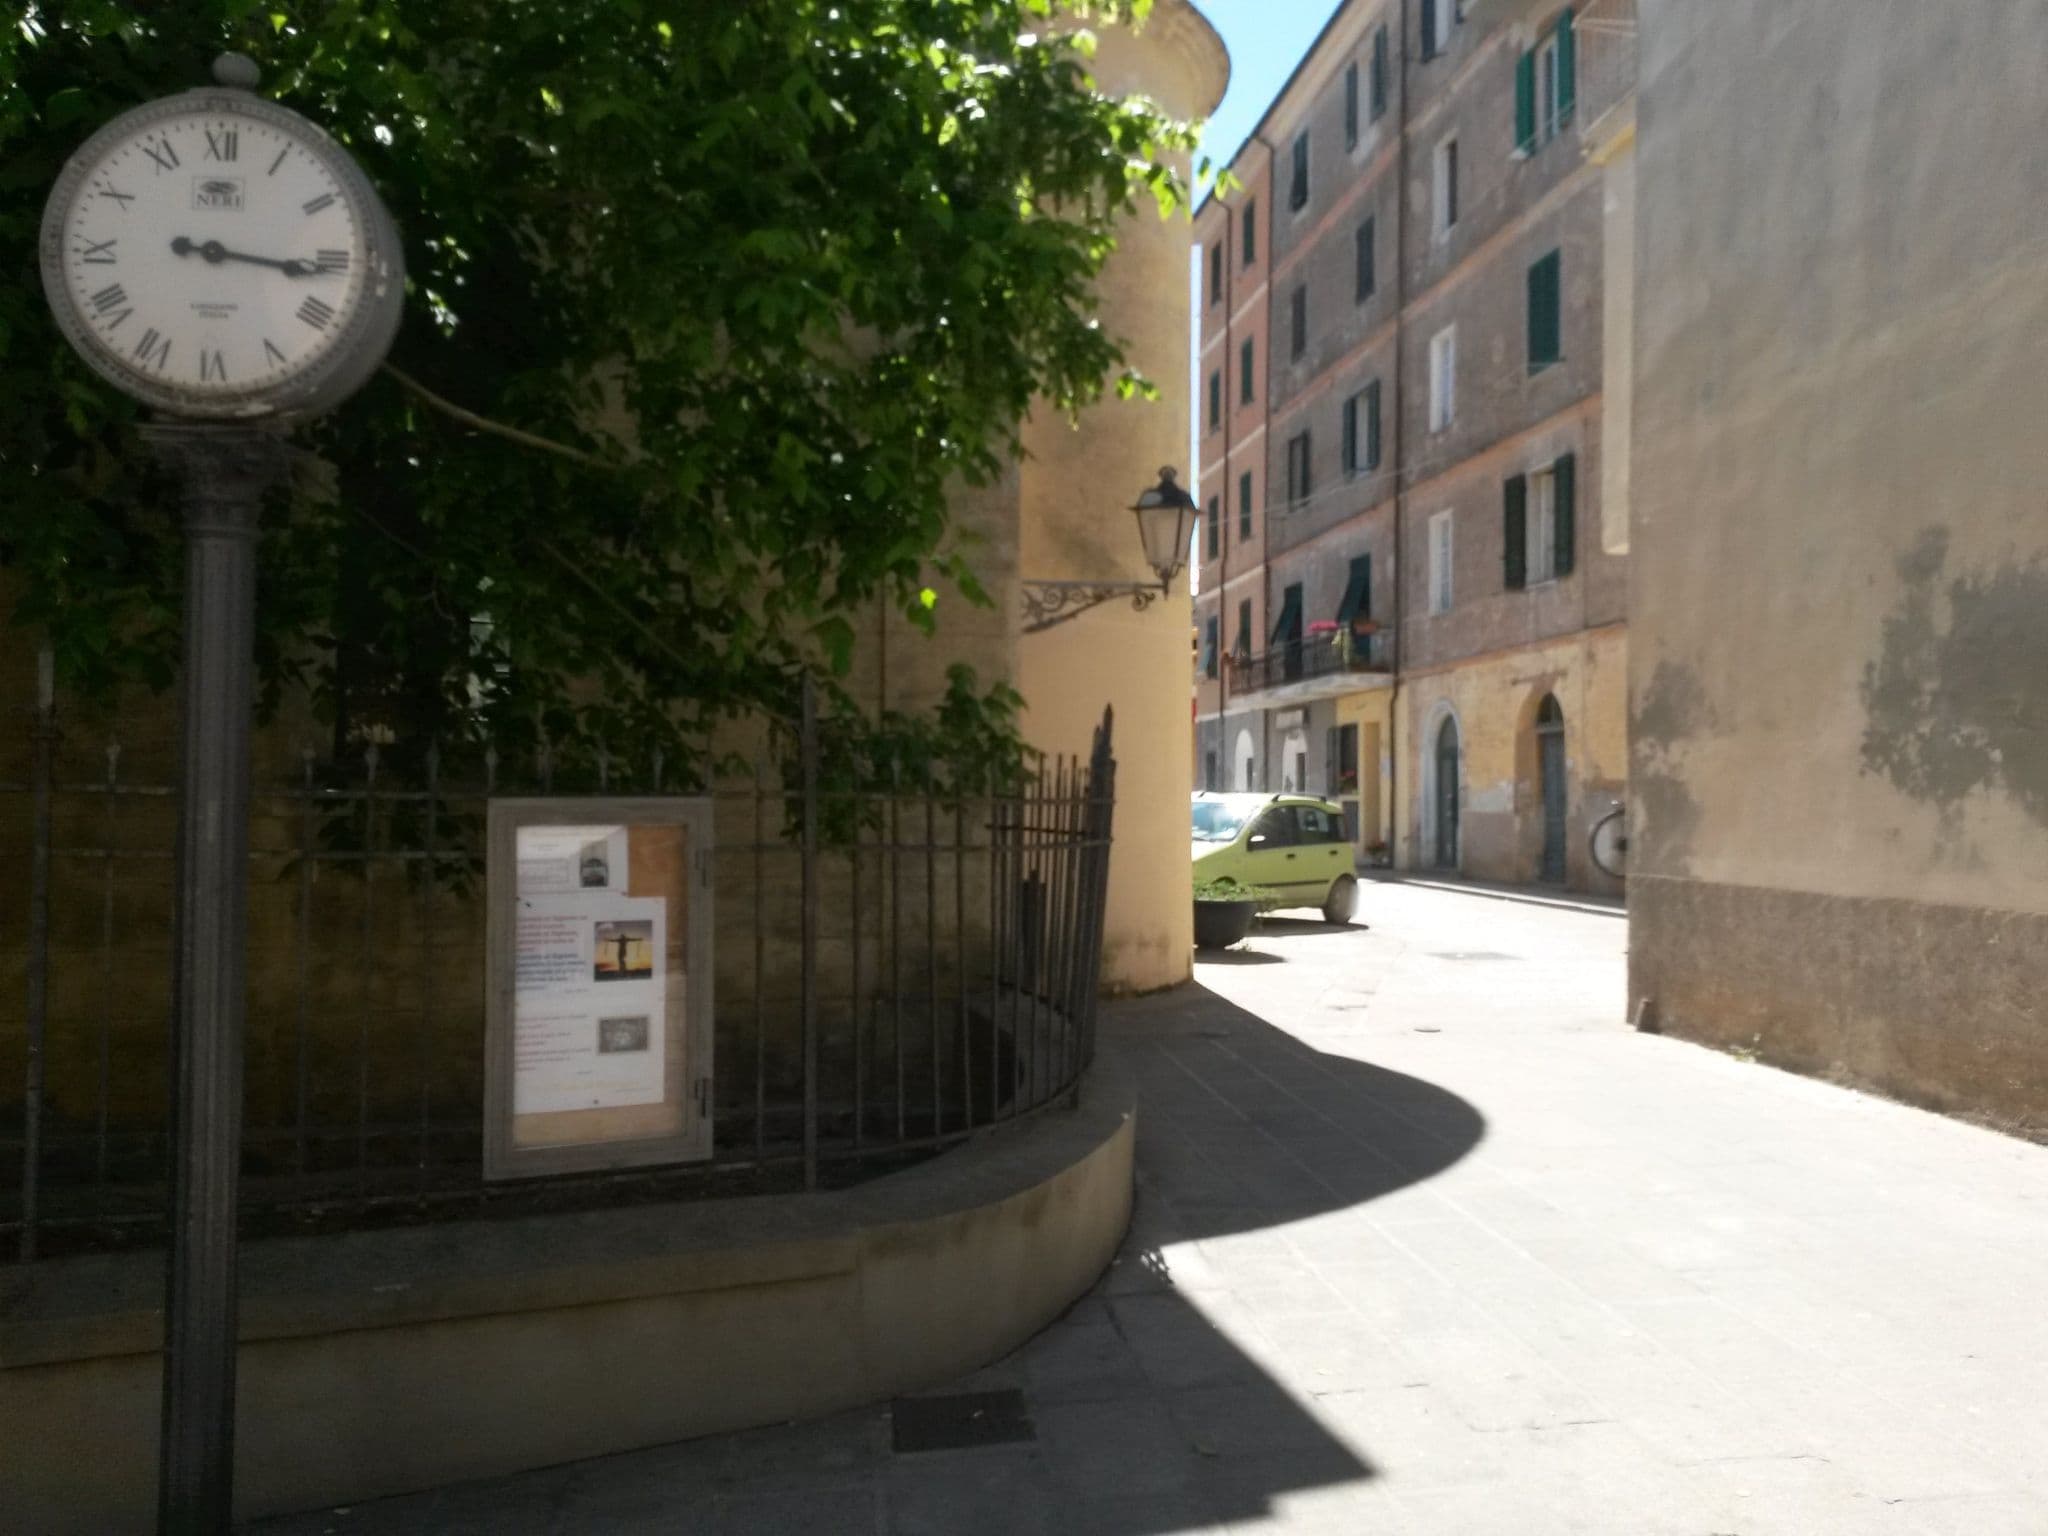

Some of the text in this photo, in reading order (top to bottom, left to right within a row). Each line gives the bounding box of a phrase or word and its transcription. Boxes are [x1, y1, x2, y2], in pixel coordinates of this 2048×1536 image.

[143, 139, 181, 175] XI
[205, 131, 238, 162] XII
[99, 180, 136, 212] X
[302, 193, 336, 217] II
[82, 237, 118, 265] IX
[134, 327, 172, 370] VII
[263, 338, 287, 369] V
[201, 351, 228, 383] VI
